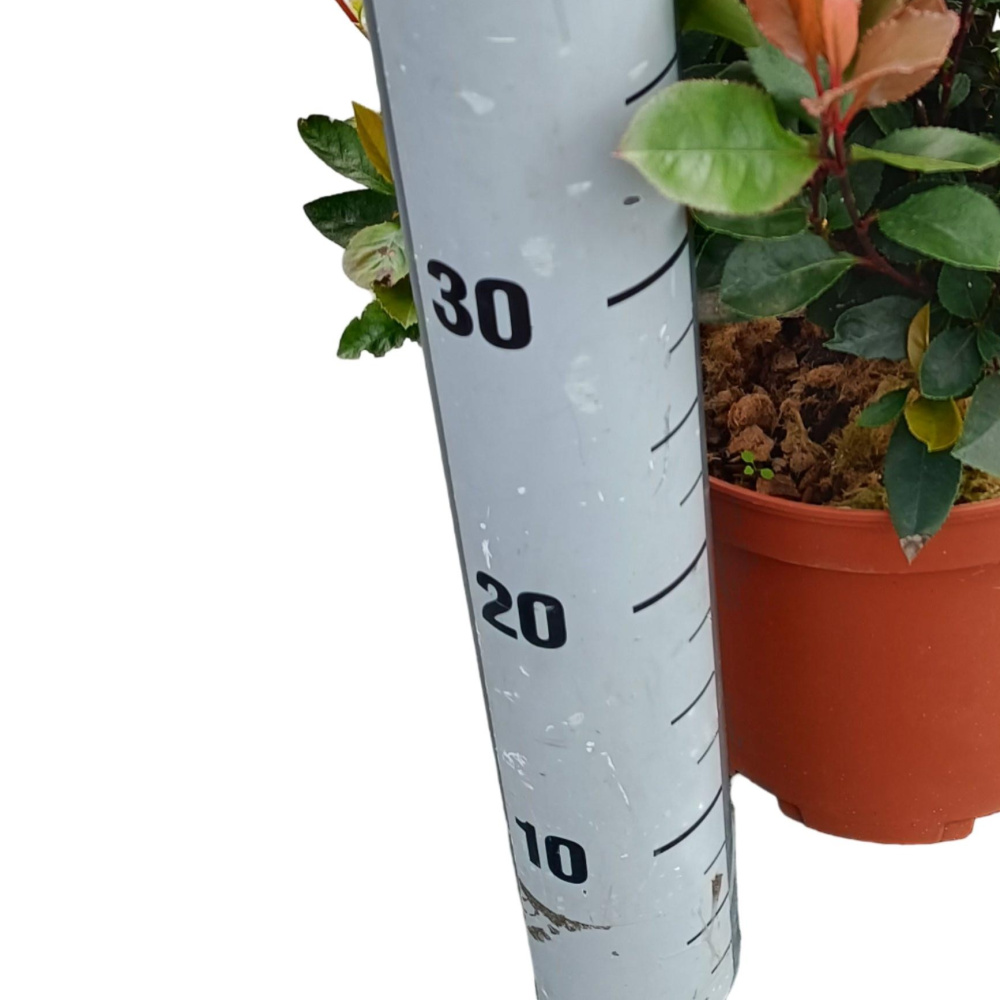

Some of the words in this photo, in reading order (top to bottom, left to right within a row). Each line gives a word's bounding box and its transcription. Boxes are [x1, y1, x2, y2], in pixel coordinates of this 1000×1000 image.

[426, 258, 532, 350] 30
[476, 570, 567, 649] 20
[515, 817, 588, 885] 10
